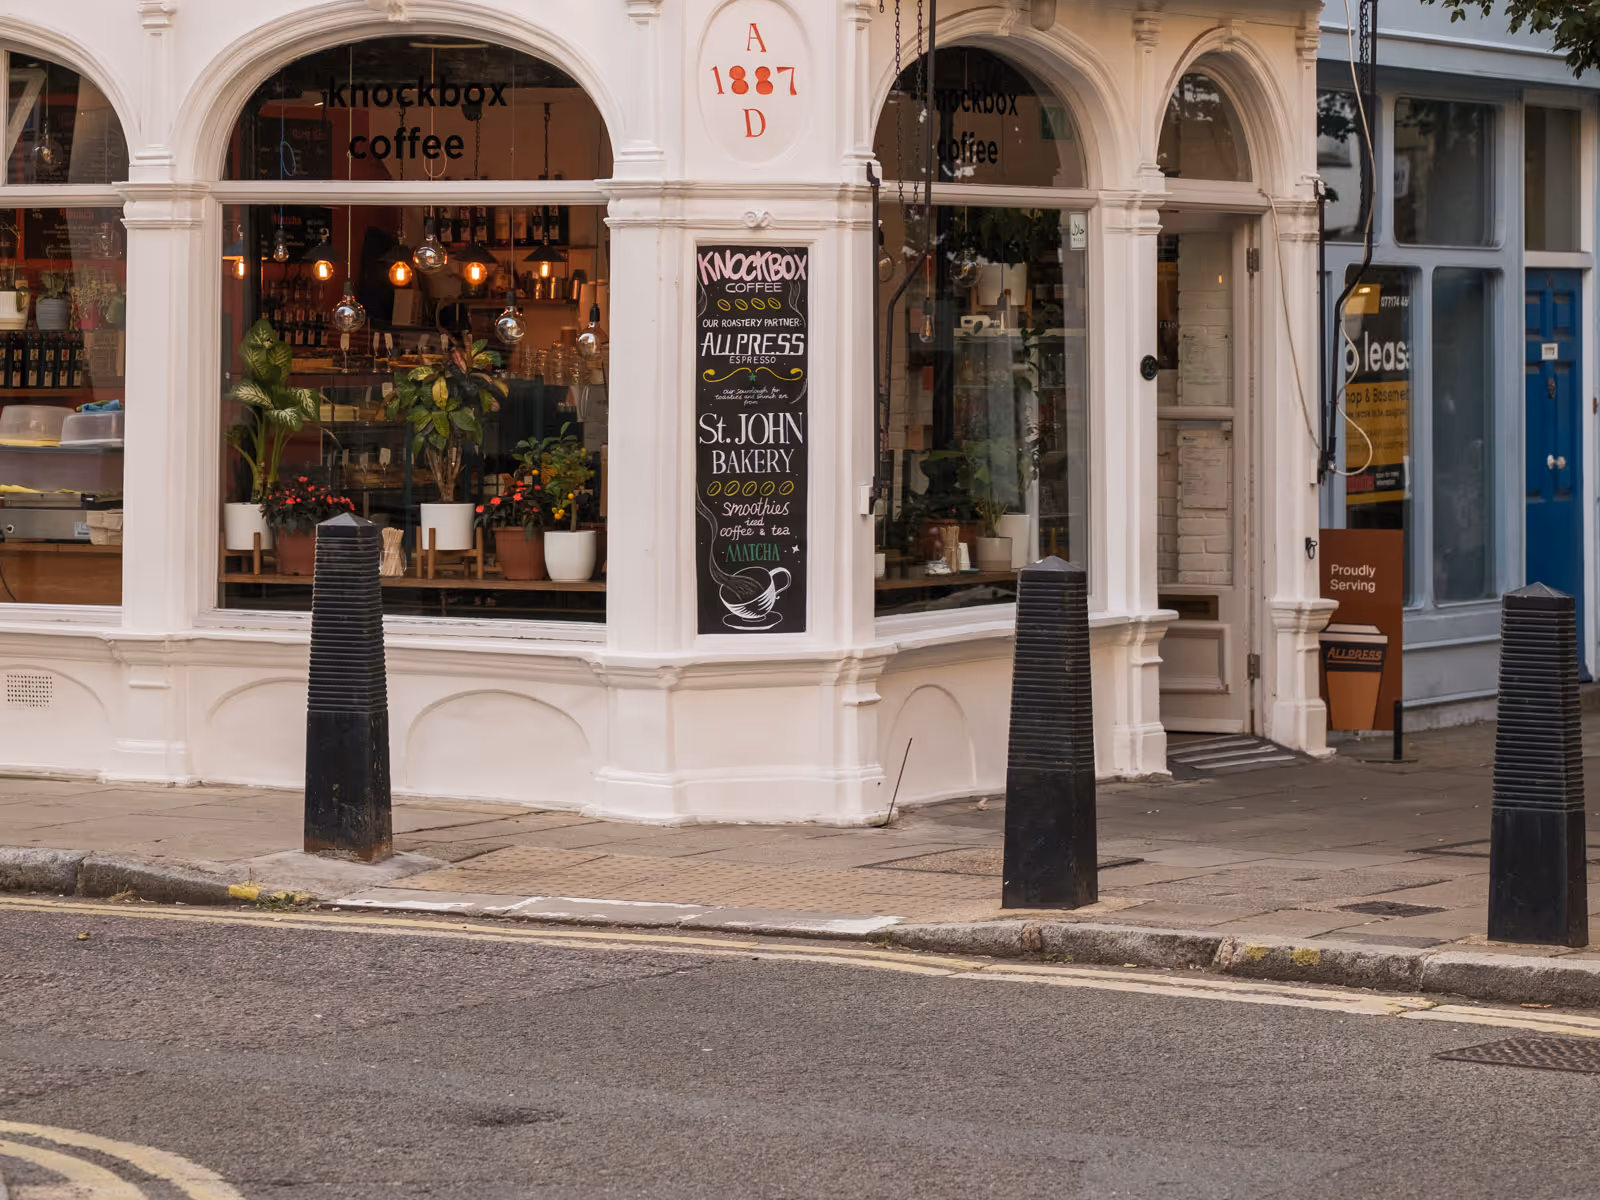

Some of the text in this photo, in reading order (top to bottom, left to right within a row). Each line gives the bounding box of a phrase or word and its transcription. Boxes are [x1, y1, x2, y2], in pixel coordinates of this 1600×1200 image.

[746, 23, 767, 52] A
[710, 65, 798, 96] 1887
[328, 76, 507, 107] knockbox
[742, 108, 767, 138] D
[349, 127, 464, 159] coffee
[698, 250, 807, 285] KNOCKBOX
[725, 282, 782, 293] COFFEE
[702, 318, 803, 328] OUR ROASTERY PARTNER:
[701, 332, 804, 356] ALLPRESS
[729, 356, 776, 364] ESPRESSO
[699, 412, 804, 445] St. JOHN
[712, 449, 795, 474] BAKERY
[744, 517, 765, 526] iced
[720, 525, 754, 541] coffee
[771, 525, 791, 536] tea
[725, 543, 781, 562] MATCHA
[1331, 564, 1376, 578] Proudly
[1330, 579, 1376, 593] Serving
[1327, 647, 1383, 661] ALLPRESS
